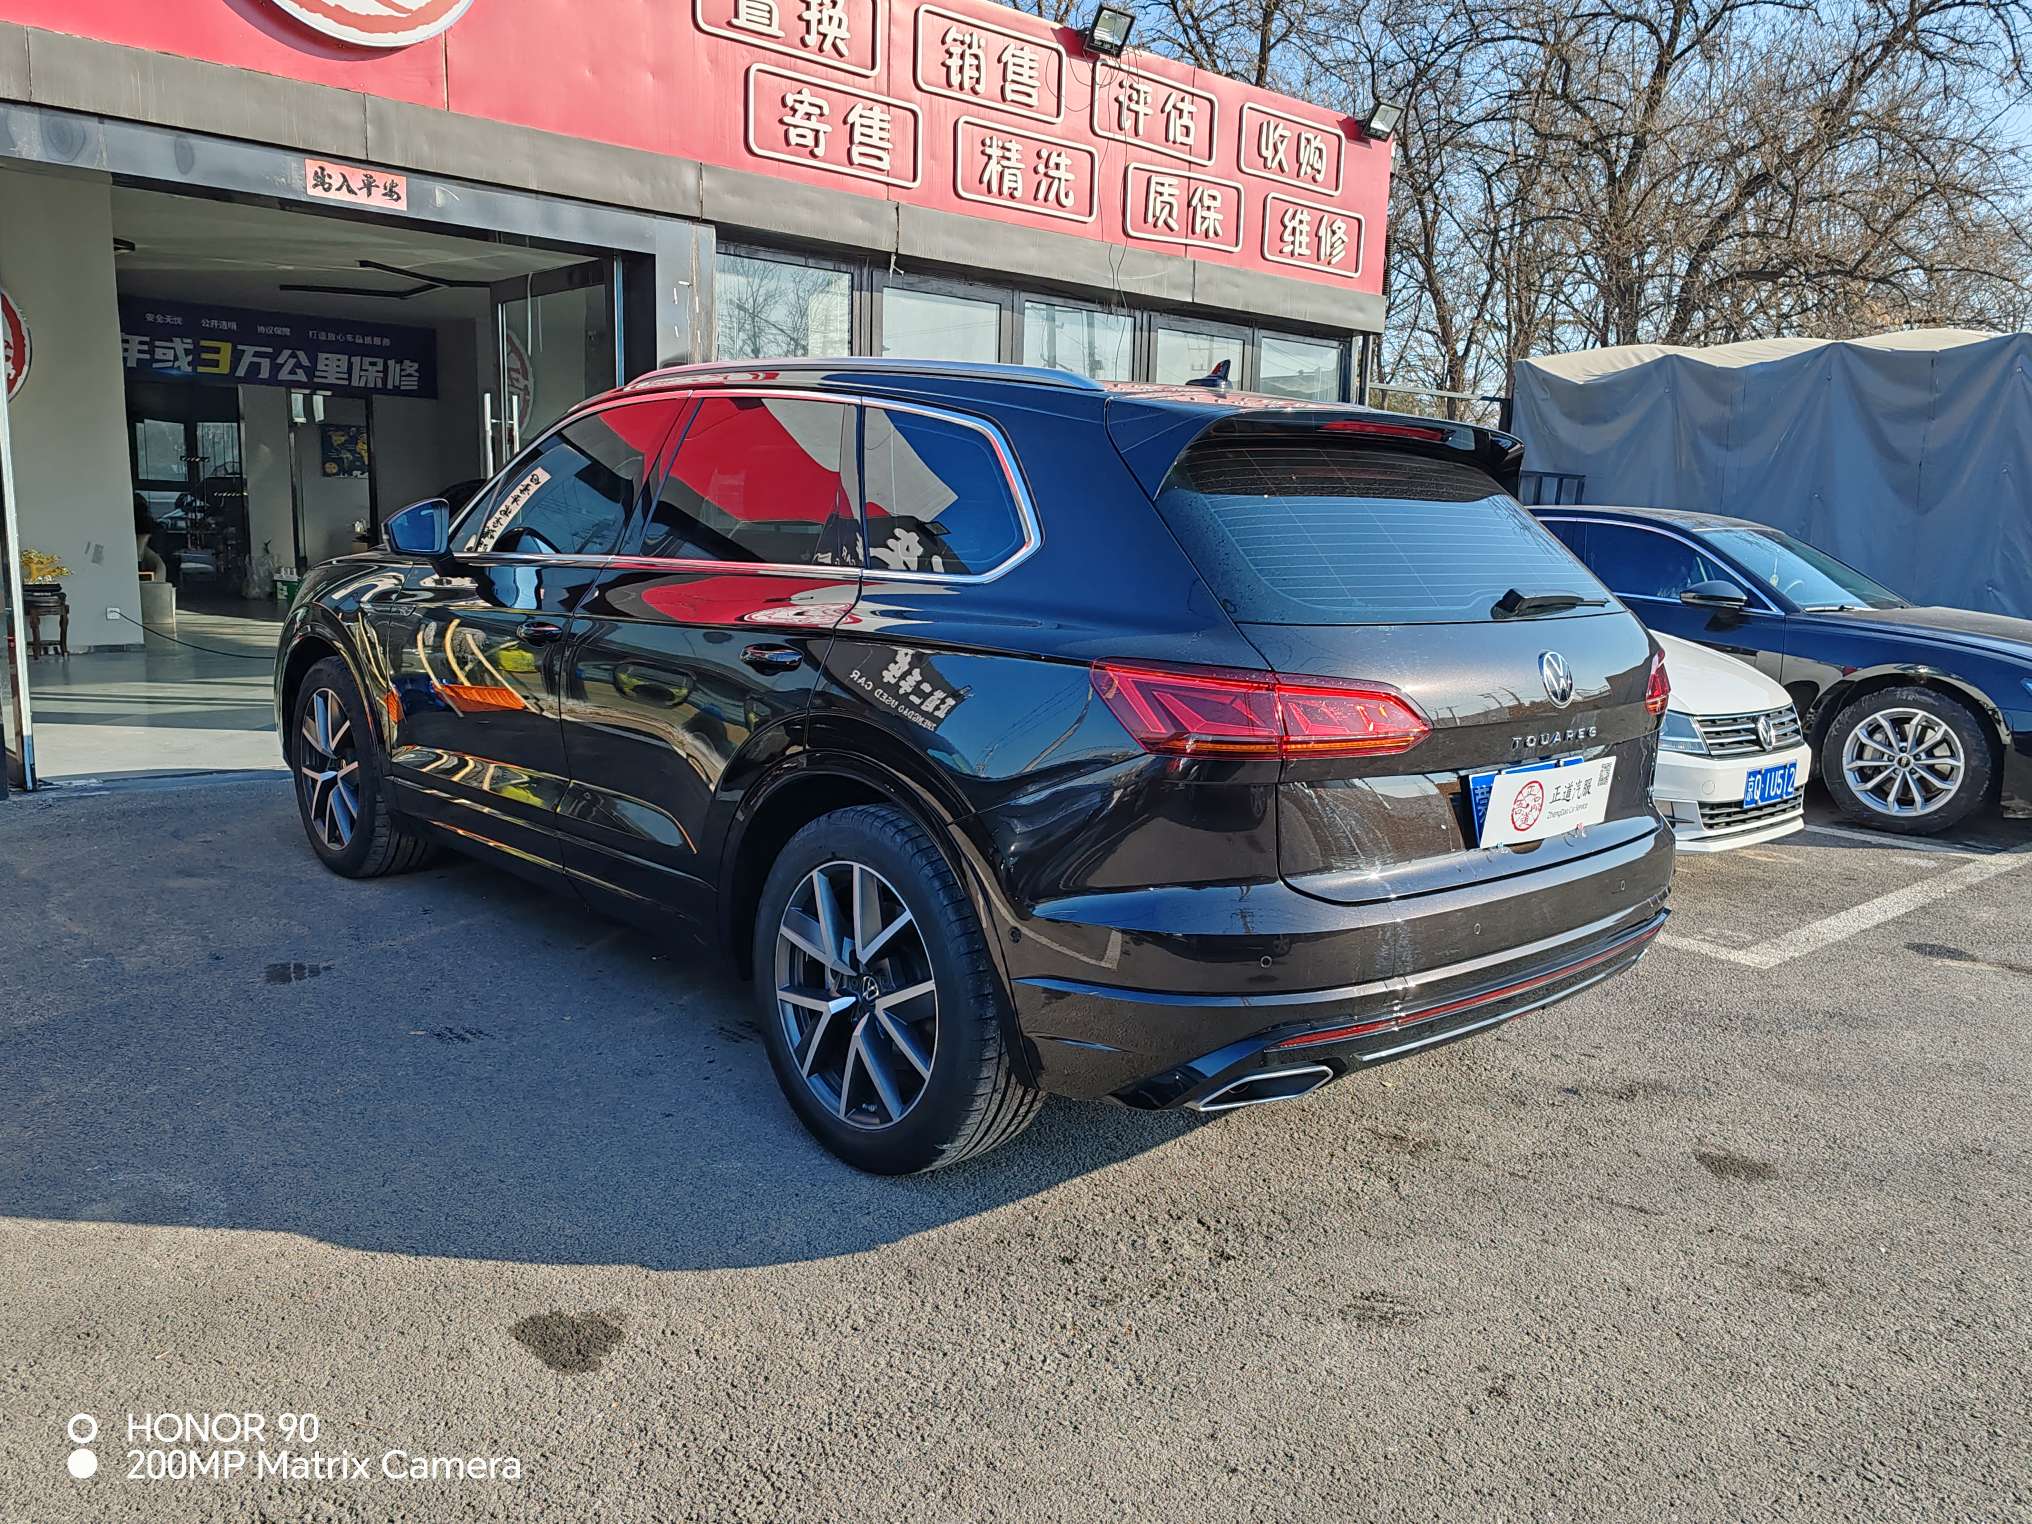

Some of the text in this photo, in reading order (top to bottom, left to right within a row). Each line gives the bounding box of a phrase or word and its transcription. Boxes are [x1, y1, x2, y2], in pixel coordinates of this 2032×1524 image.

[942, 26, 1041, 108] 销售
[781, 87, 893, 171] 寄售
[1115, 80, 1198, 145] 评估
[980, 135, 1075, 207] 精洗
[1259, 119, 1326, 183] 收购
[312, 166, 401, 202] 出入平安
[1146, 175, 1224, 238] 质保
[1281, 208, 1349, 265] 维修
[1511, 726, 1597, 749] TOUAREG
